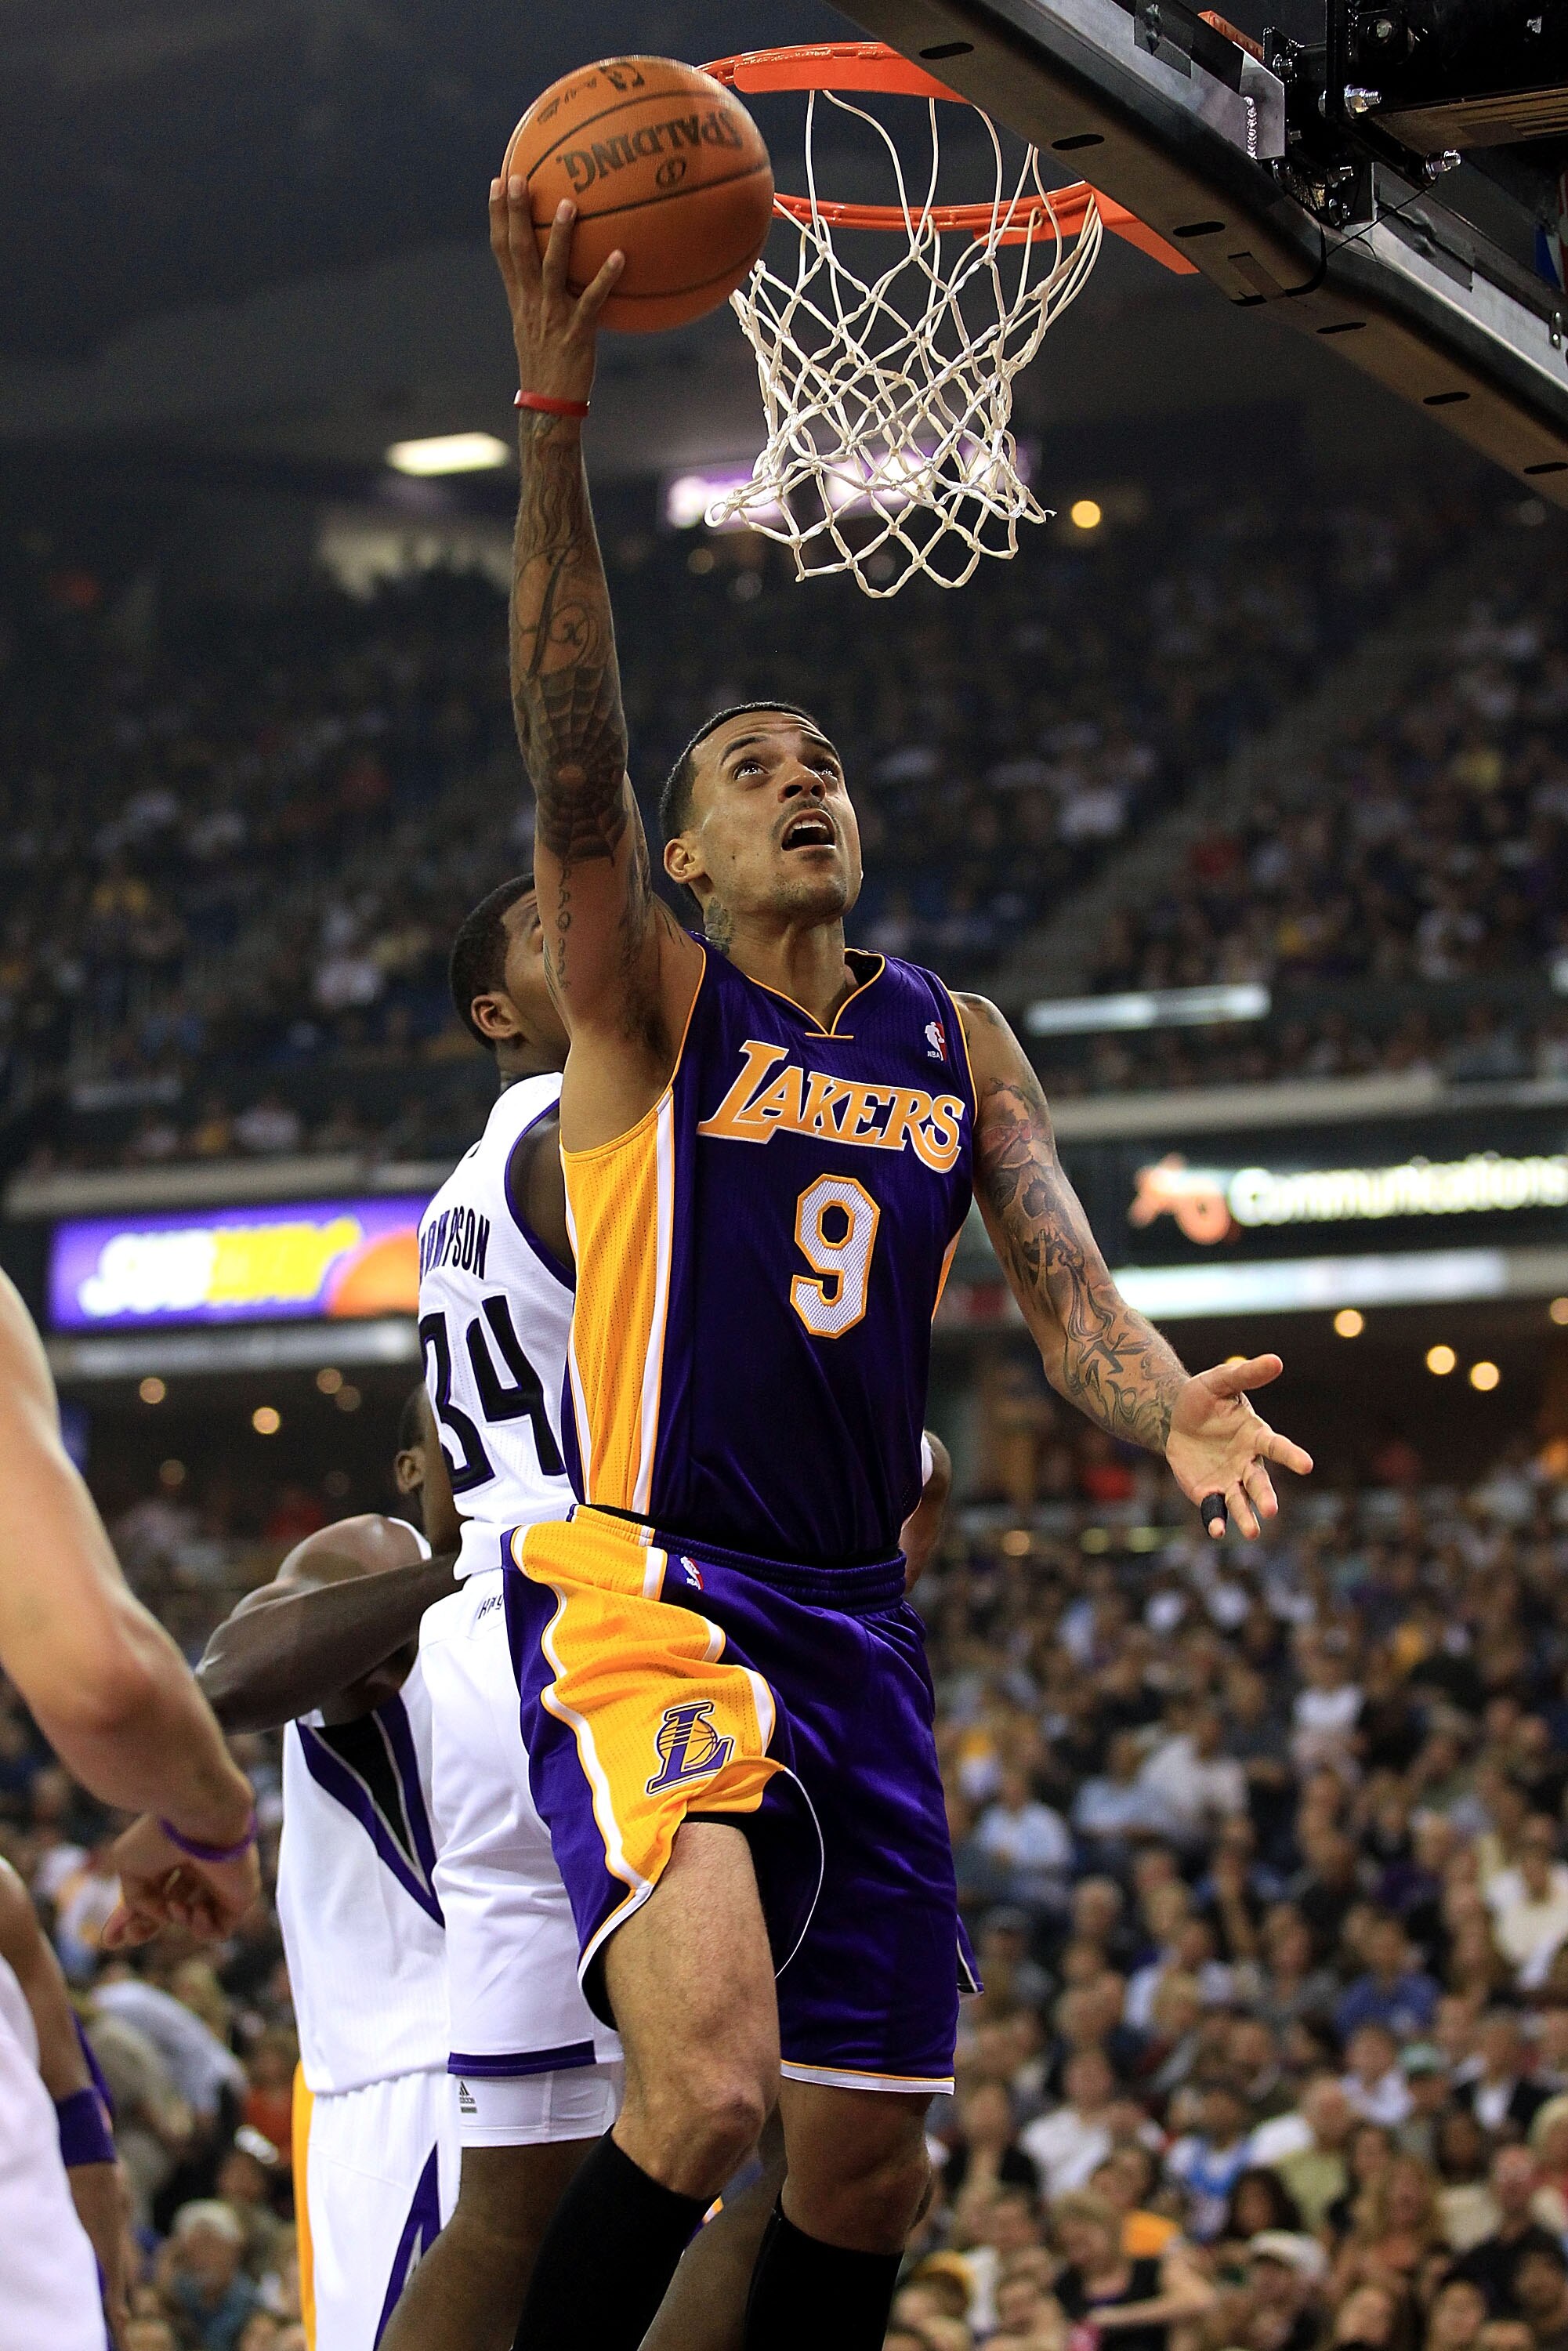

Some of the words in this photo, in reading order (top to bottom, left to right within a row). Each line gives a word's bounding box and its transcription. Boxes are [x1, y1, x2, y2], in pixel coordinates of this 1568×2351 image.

[557, 110, 743, 194] SPALDING
[696, 1039, 965, 1174] LAKERS
[927, 1050, 941, 1060] NBA
[790, 1173, 881, 1339] 9
[418, 1295, 567, 1494] 34
